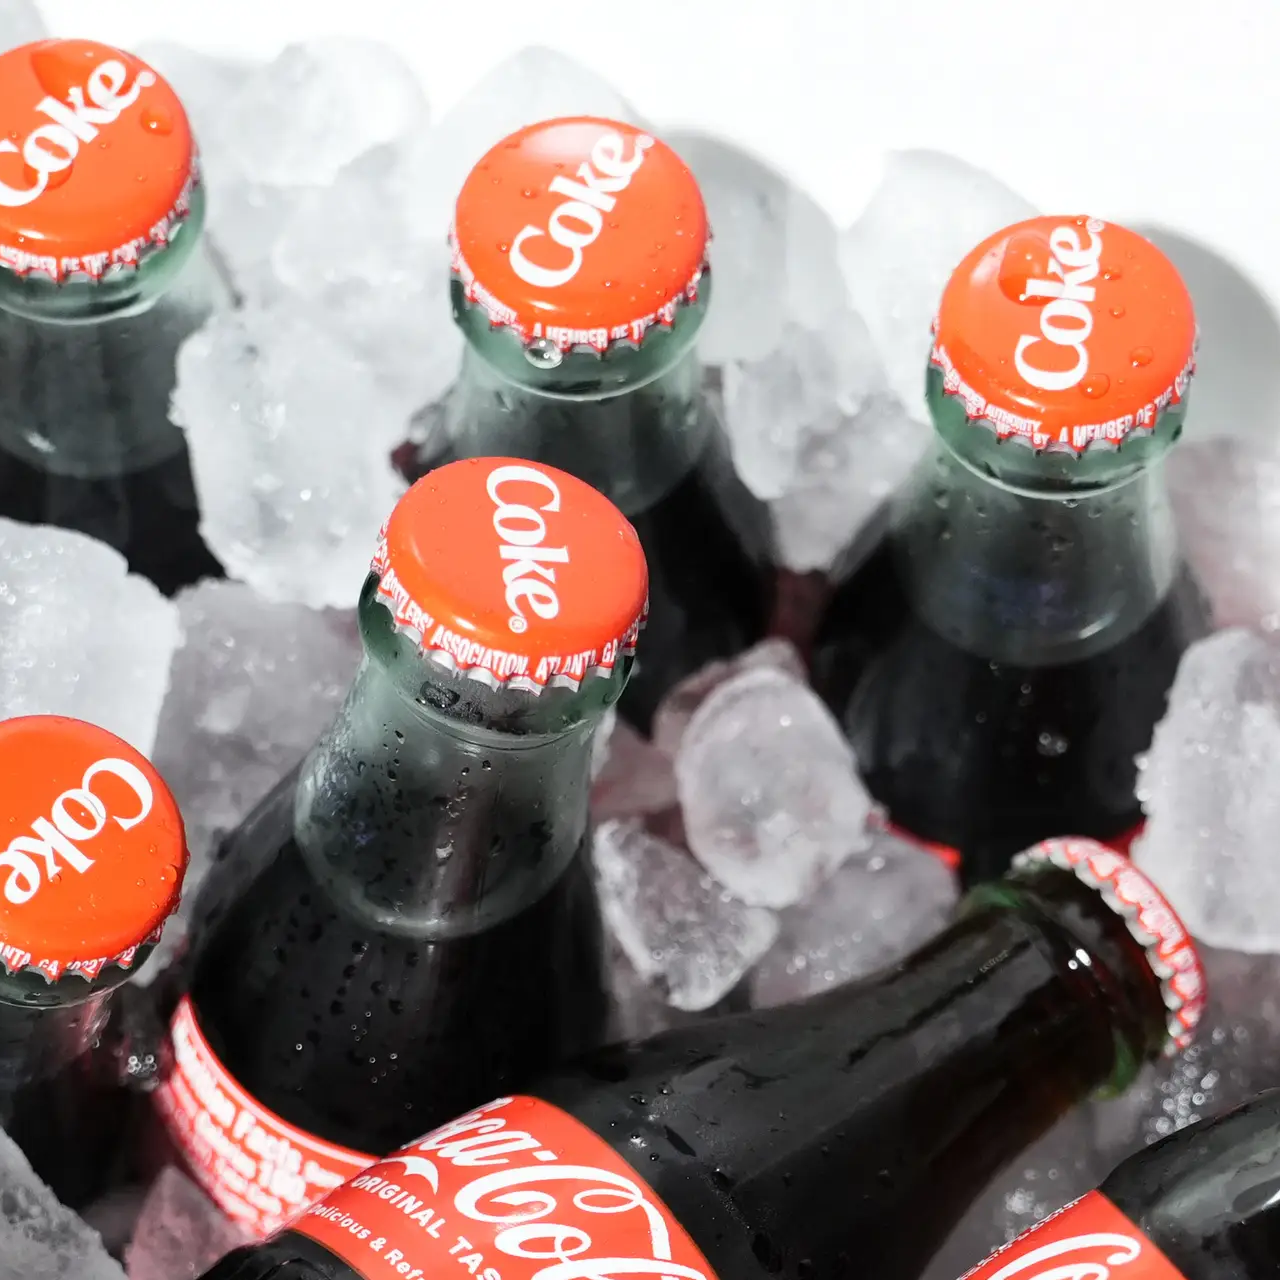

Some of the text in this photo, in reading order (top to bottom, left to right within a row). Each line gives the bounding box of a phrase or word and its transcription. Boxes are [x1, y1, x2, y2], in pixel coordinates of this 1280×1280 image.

[509, 133, 644, 288] Coke
[1015, 227, 1102, 390] Coke
[486, 465, 569, 620] Coke
[310, 1203, 372, 1239] Delicious
[370, 1237, 387, 1252] &
[351, 1175, 447, 1239] ORIGINAL
